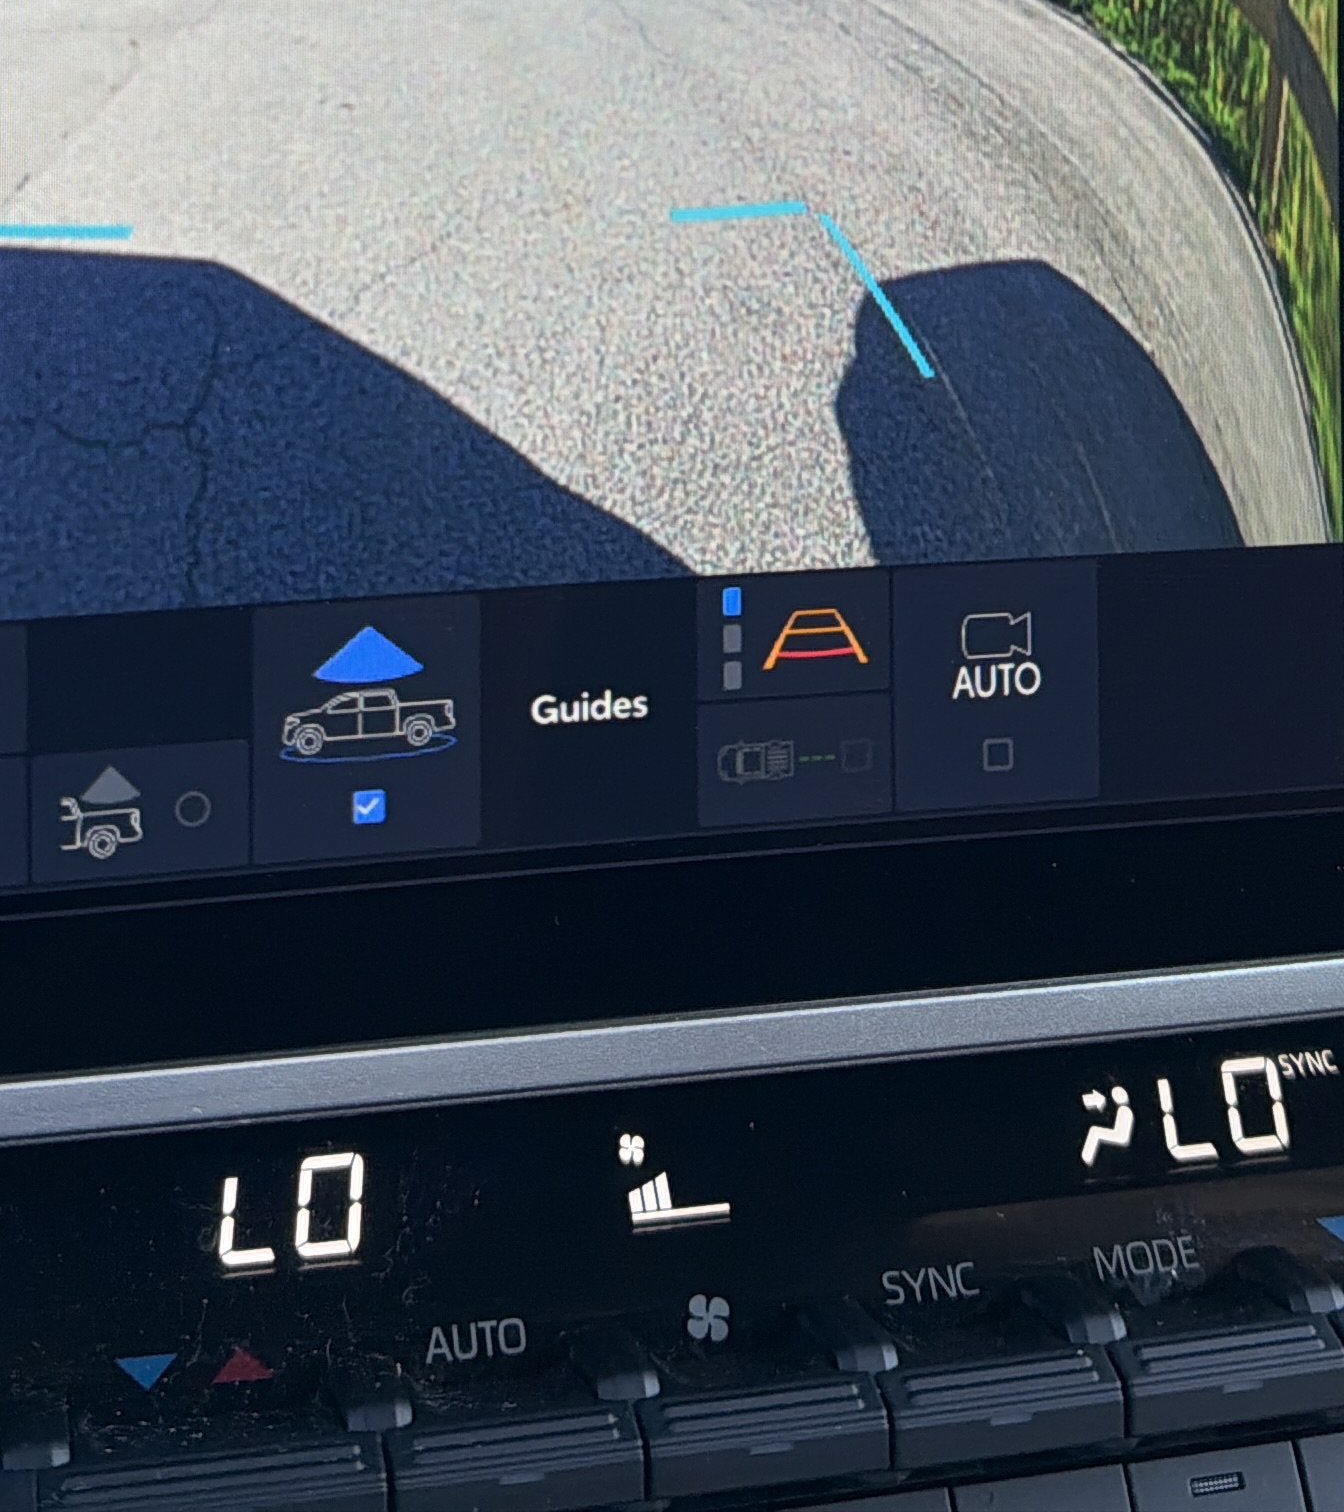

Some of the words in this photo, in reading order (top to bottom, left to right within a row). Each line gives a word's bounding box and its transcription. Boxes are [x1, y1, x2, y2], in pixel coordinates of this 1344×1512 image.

[952, 662, 1042, 700] AUTO
[531, 691, 649, 725] Guides
[1156, 1056, 1290, 1162] LO
[1277, 1048, 1340, 1080] SYNC
[218, 1151, 364, 1267] LO
[1092, 1235, 1200, 1282] MODE
[881, 1261, 981, 1306] SYNC
[425, 1317, 527, 1364] AUTO
